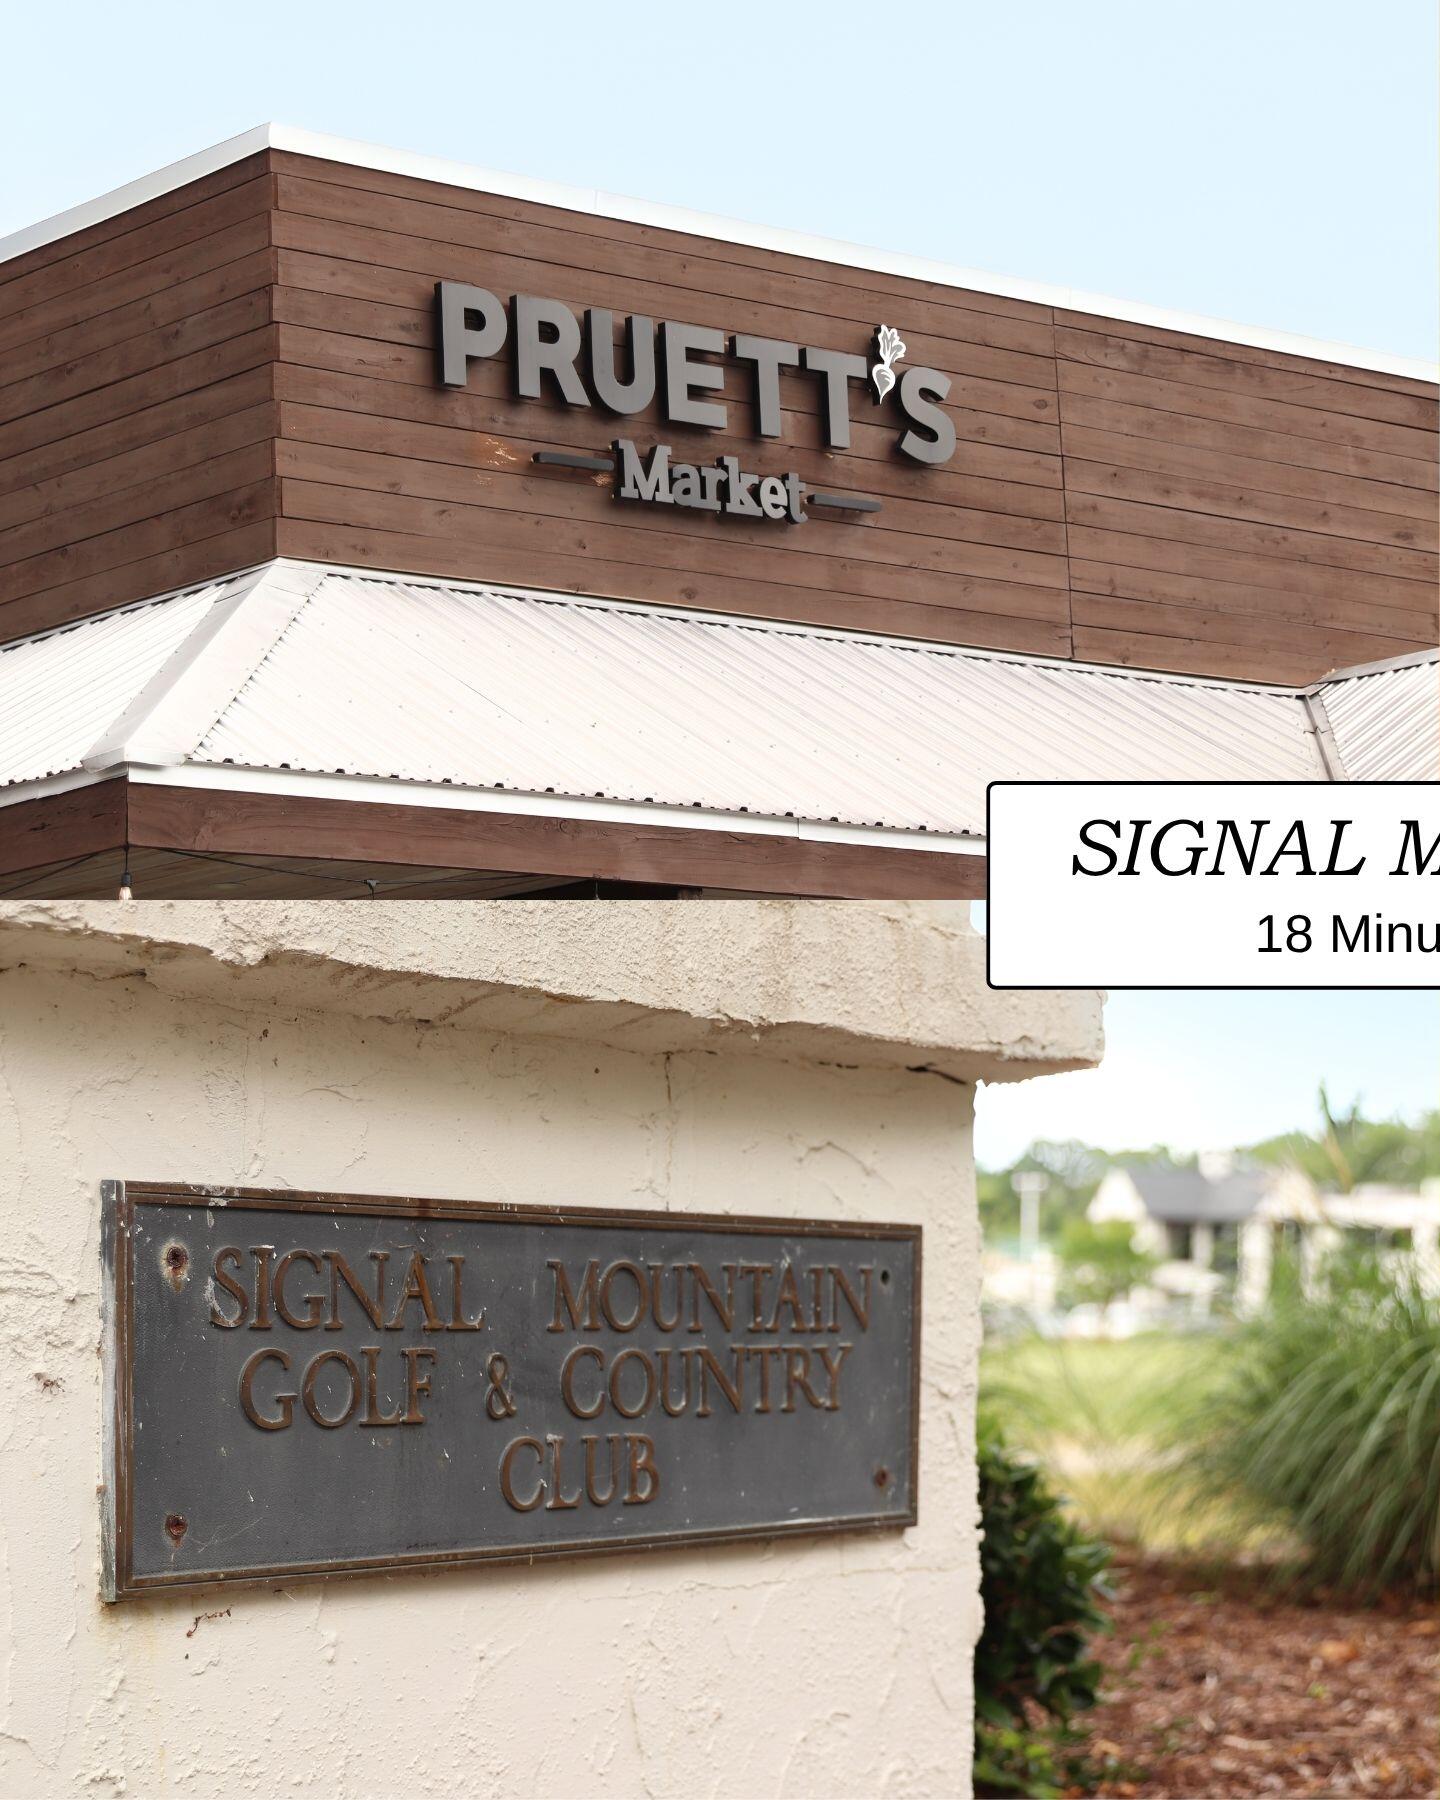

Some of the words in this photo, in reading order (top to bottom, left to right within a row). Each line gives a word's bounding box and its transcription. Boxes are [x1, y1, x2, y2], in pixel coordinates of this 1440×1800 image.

[434, 281, 958, 464] PRUETT'S
[611, 438, 808, 524] Market
[208, 1244, 484, 1332] SIGNAL
[546, 1258, 874, 1334] MOUNTAIN
[240, 1345, 437, 1430] GOLF
[484, 1352, 517, 1420] &
[560, 1342, 854, 1419] COUNTRY
[498, 1432, 661, 1512] CLUB
